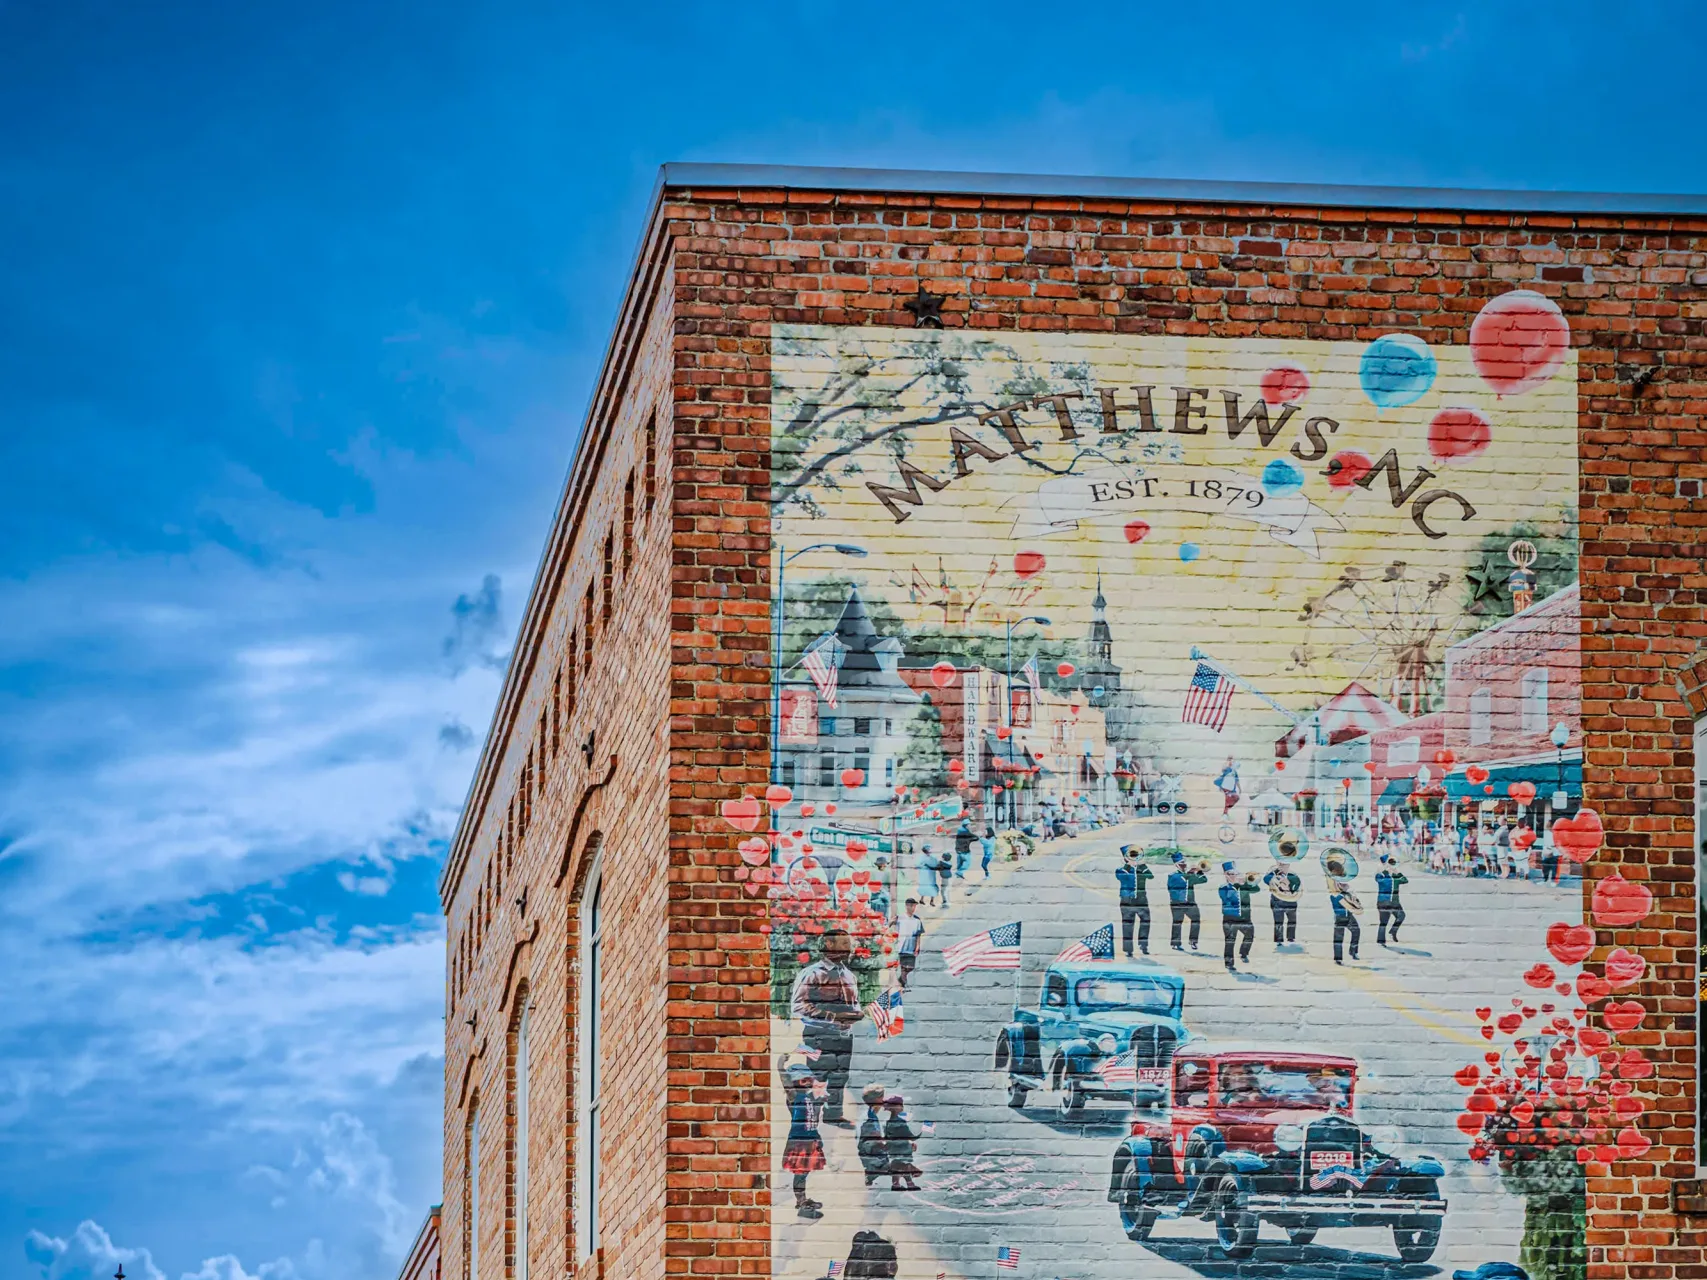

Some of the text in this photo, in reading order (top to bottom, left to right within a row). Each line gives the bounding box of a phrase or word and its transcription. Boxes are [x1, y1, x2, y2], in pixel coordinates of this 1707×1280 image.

[864, 384, 1478, 540] MATTHEWS, NC
[1087, 478, 1264, 509] EST. 1879
[967, 677, 976, 776] HARDWARE
